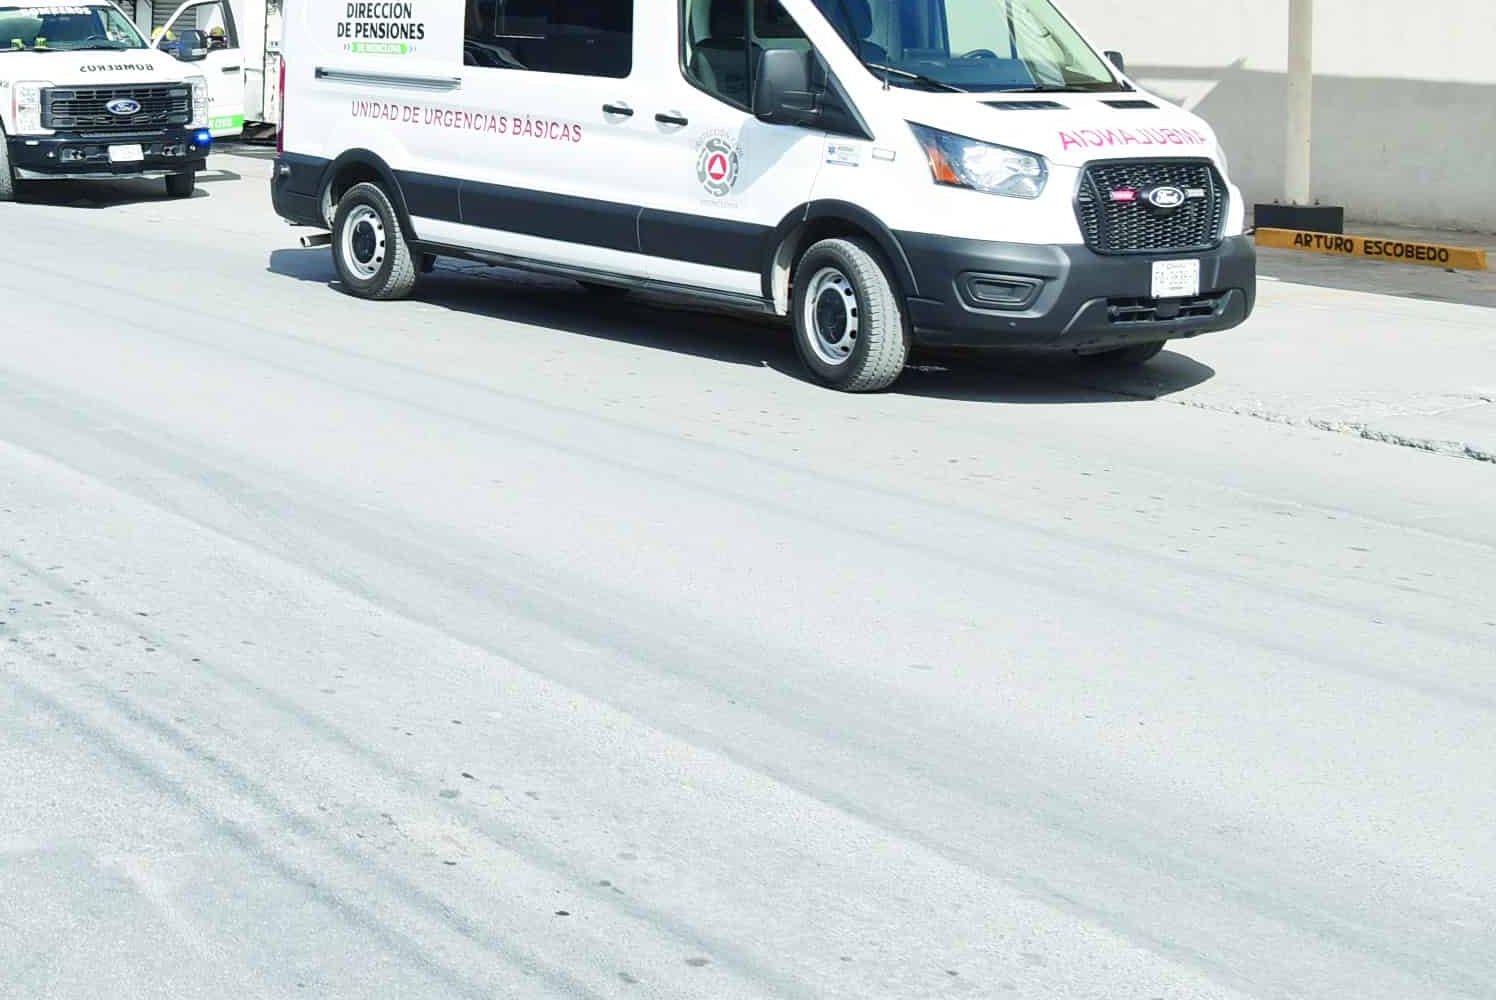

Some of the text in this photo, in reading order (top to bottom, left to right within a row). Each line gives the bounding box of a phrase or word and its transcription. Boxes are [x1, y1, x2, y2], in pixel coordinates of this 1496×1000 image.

[337, 22, 425, 40] DE PENSIONES
[351, 100, 583, 143] UNIDAD DE URGENCIAS BÁSICAS
[1294, 233, 1449, 263] ARTURO ESCOBEDO
